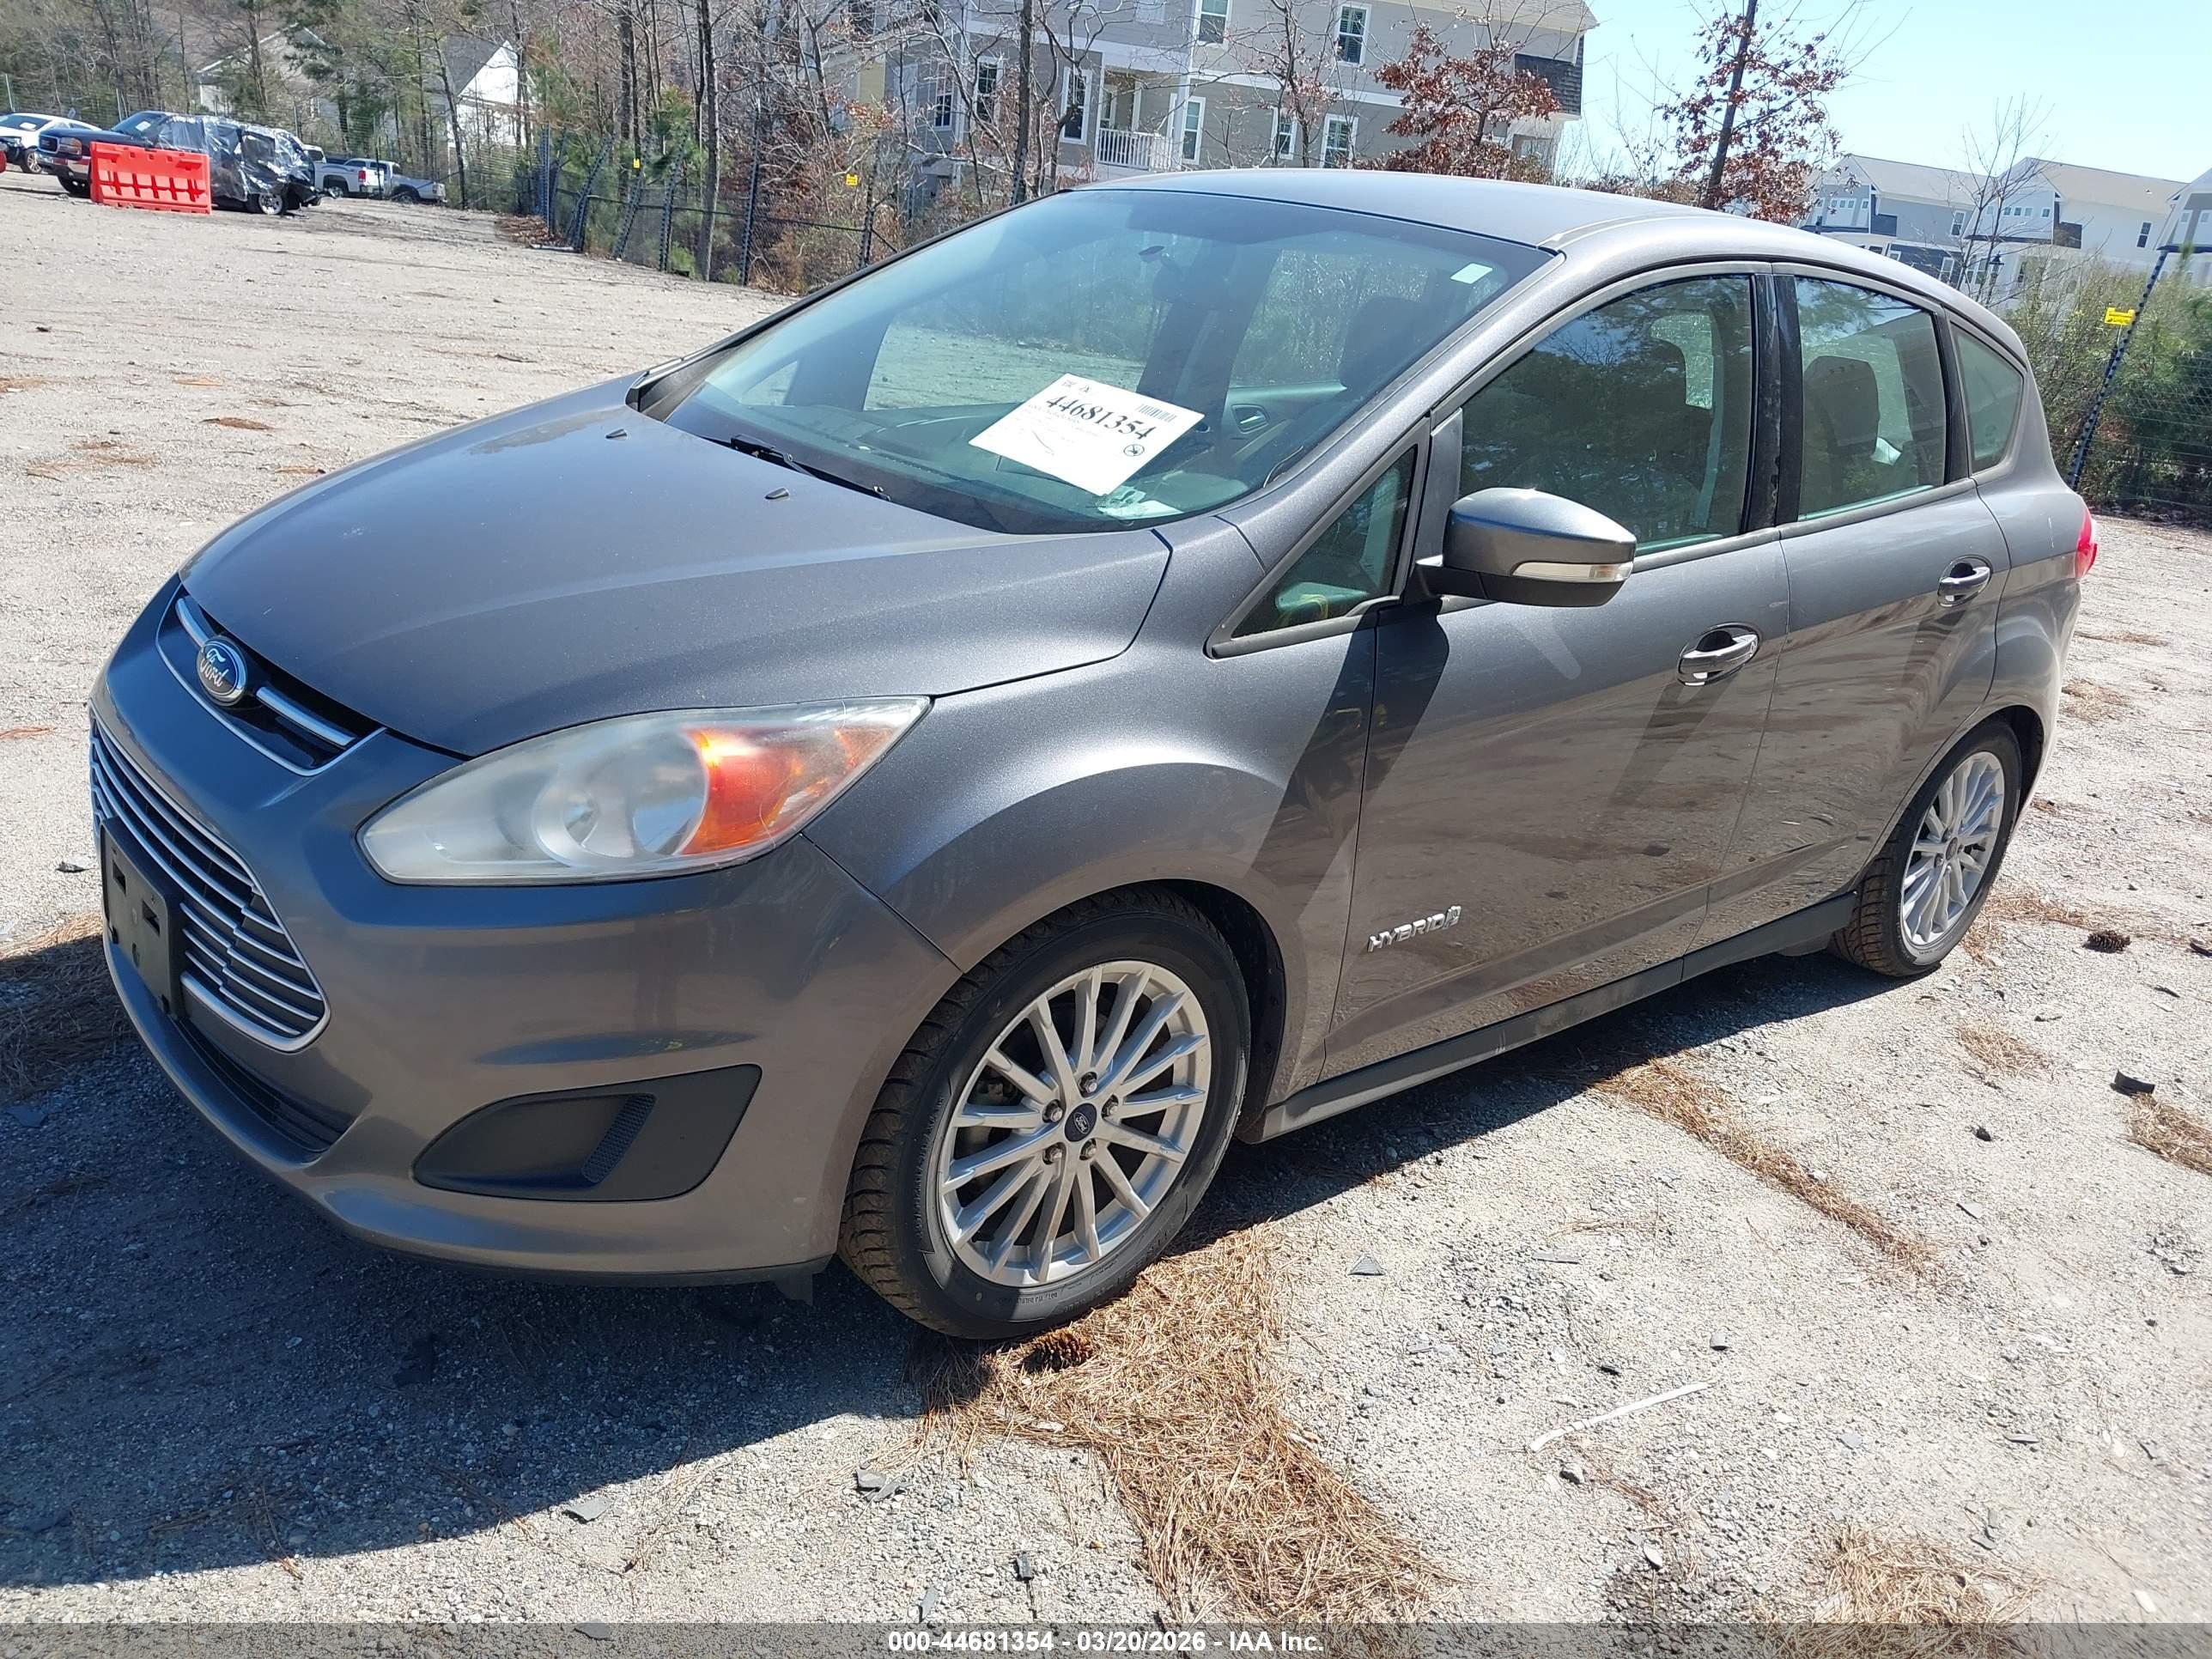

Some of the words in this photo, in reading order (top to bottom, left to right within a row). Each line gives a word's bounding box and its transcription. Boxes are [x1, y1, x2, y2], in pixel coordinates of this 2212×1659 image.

[1046, 395, 1157, 440] 44681354
[200, 648, 229, 687] Ford
[1367, 913, 1445, 952] HYBRID
